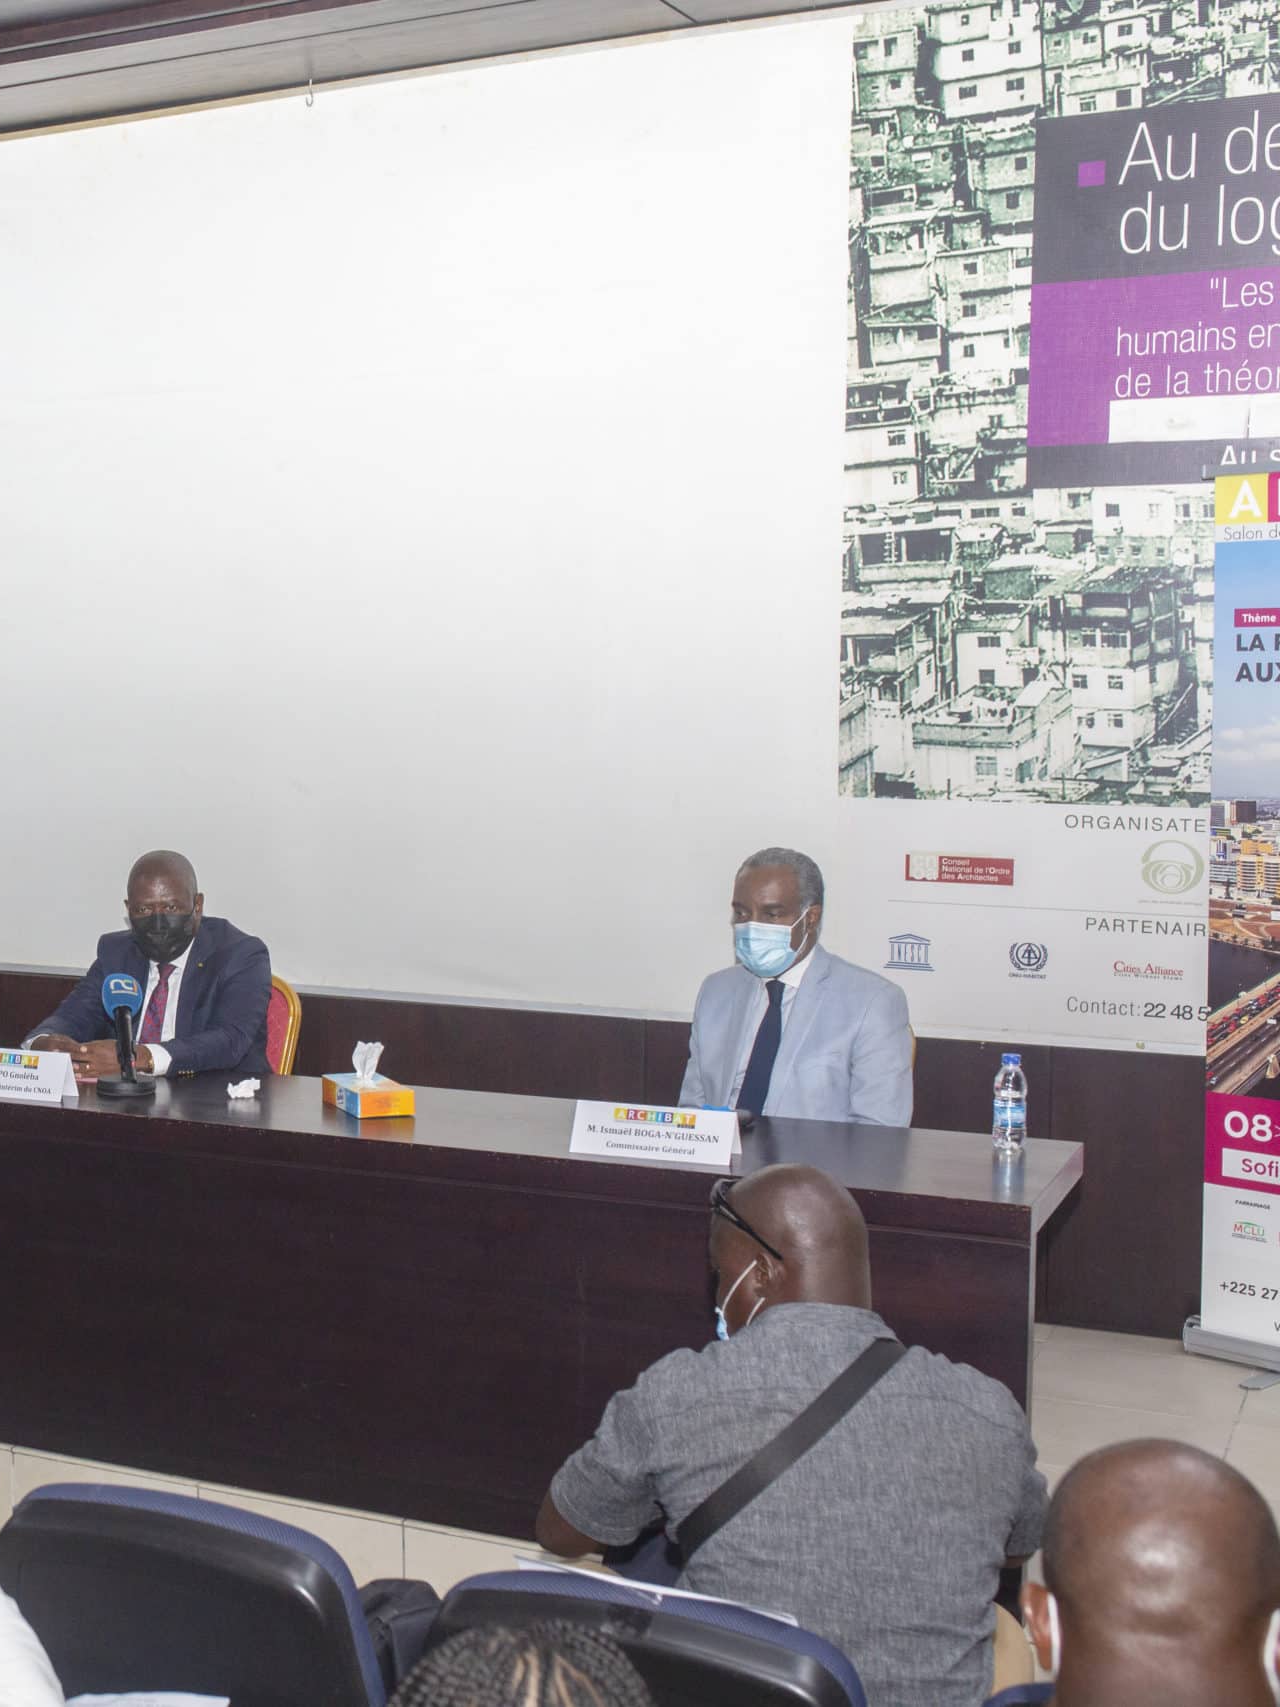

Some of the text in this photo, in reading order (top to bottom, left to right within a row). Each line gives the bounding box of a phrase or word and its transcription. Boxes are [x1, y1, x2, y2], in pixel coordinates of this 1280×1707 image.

[1117, 121, 1198, 186] Au
[1119, 184, 1280, 257] du lo
[1209, 277, 1274, 309] "Les
[1116, 320, 1237, 357] humains
[1114, 367, 1151, 399] de
[1166, 365, 1191, 396] la
[1228, 476, 1280, 520] A
[1223, 525, 1263, 541] Salon
[1241, 613, 1277, 624] Thème
[1235, 632, 1266, 653] LA
[1113, 960, 1185, 977] Cities Alliance
[1066, 995, 1141, 1017] Contact:
[1143, 1002, 1167, 1019] 22
[1170, 1004, 1193, 1021] 48
[617, 1109, 695, 1126] ARCHIBAT
[587, 1124, 720, 1144] M. Ismaël BOGA-N'GUESSAN
[605, 1140, 696, 1156] Commissaire Général
[1233, 1223, 1265, 1237] MCLU
[1220, 1280, 1279, 1301] +225 27
